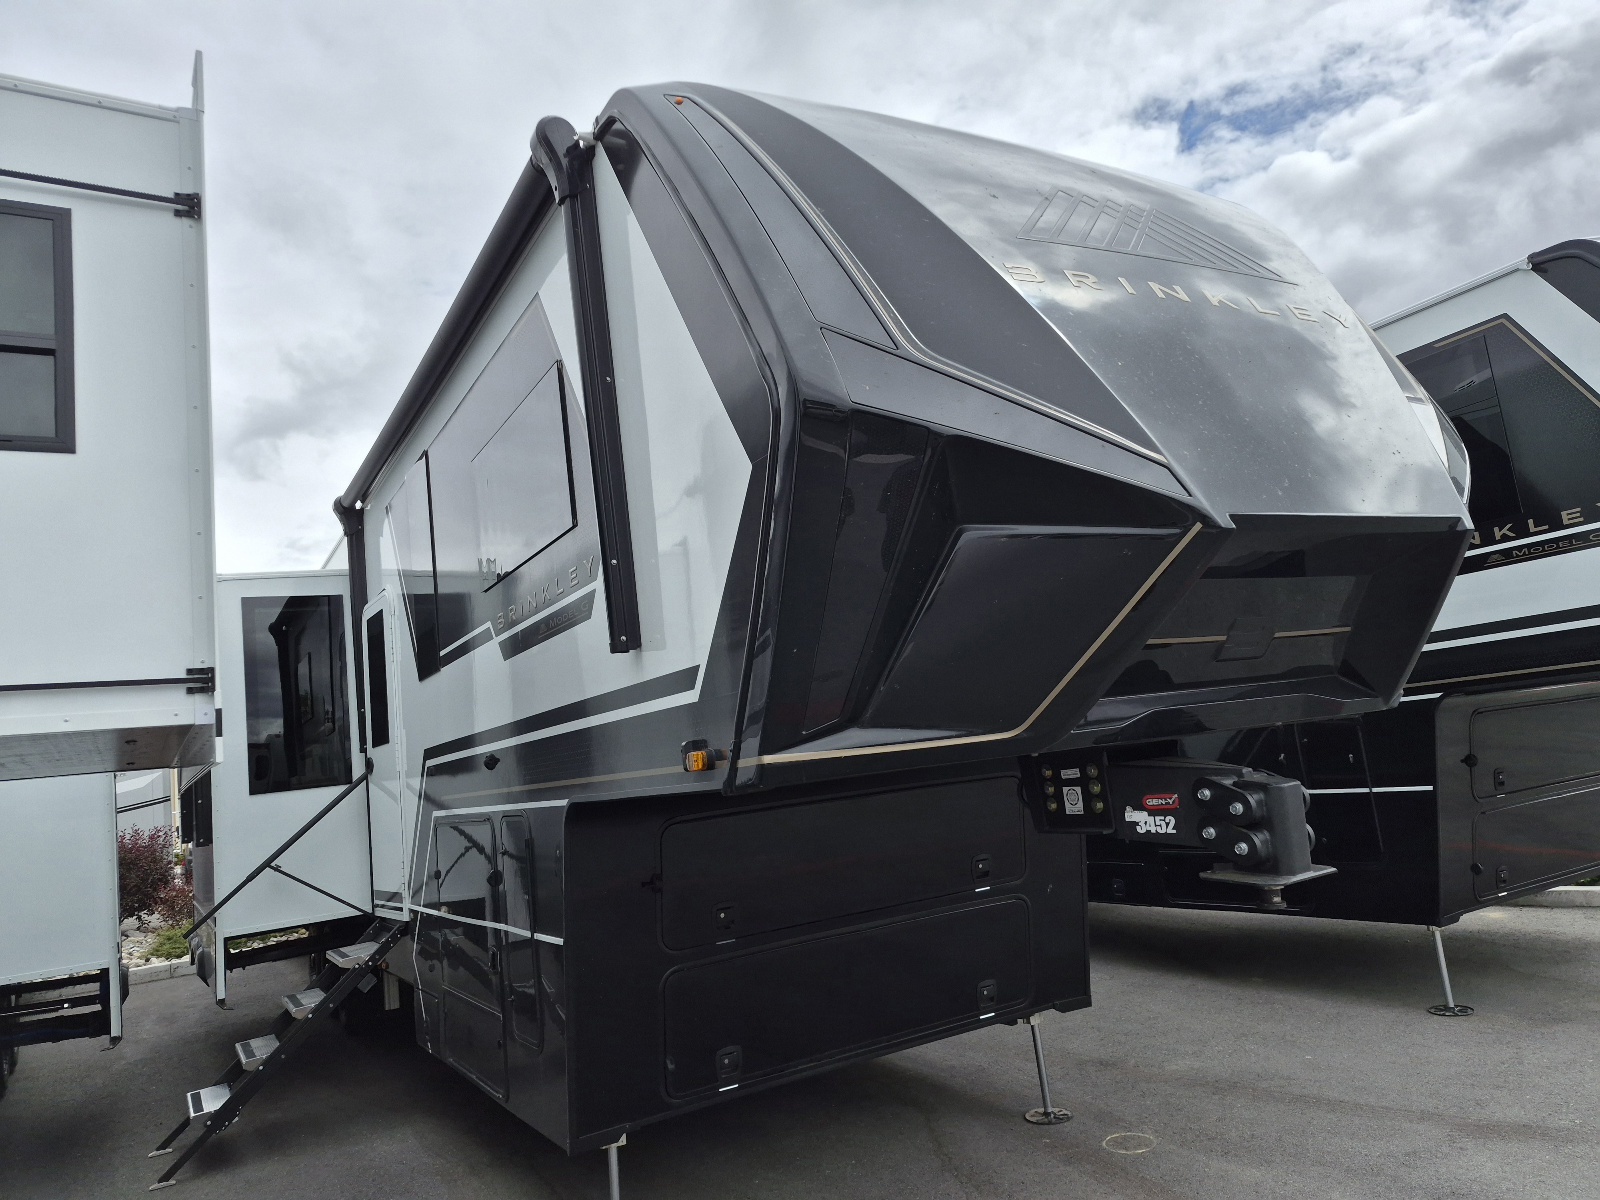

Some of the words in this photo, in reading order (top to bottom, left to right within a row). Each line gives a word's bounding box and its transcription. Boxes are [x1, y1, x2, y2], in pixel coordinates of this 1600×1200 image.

[1002, 262, 1349, 329] BRINKLEY
[1512, 538, 1582, 558] MODEL
[497, 555, 595, 630] BRINKLEY
[549, 608, 578, 629] MODEL
[581, 600, 589, 611] G
[1146, 794, 1178, 806] GEN-Y
[1136, 816, 1177, 834] 3452
